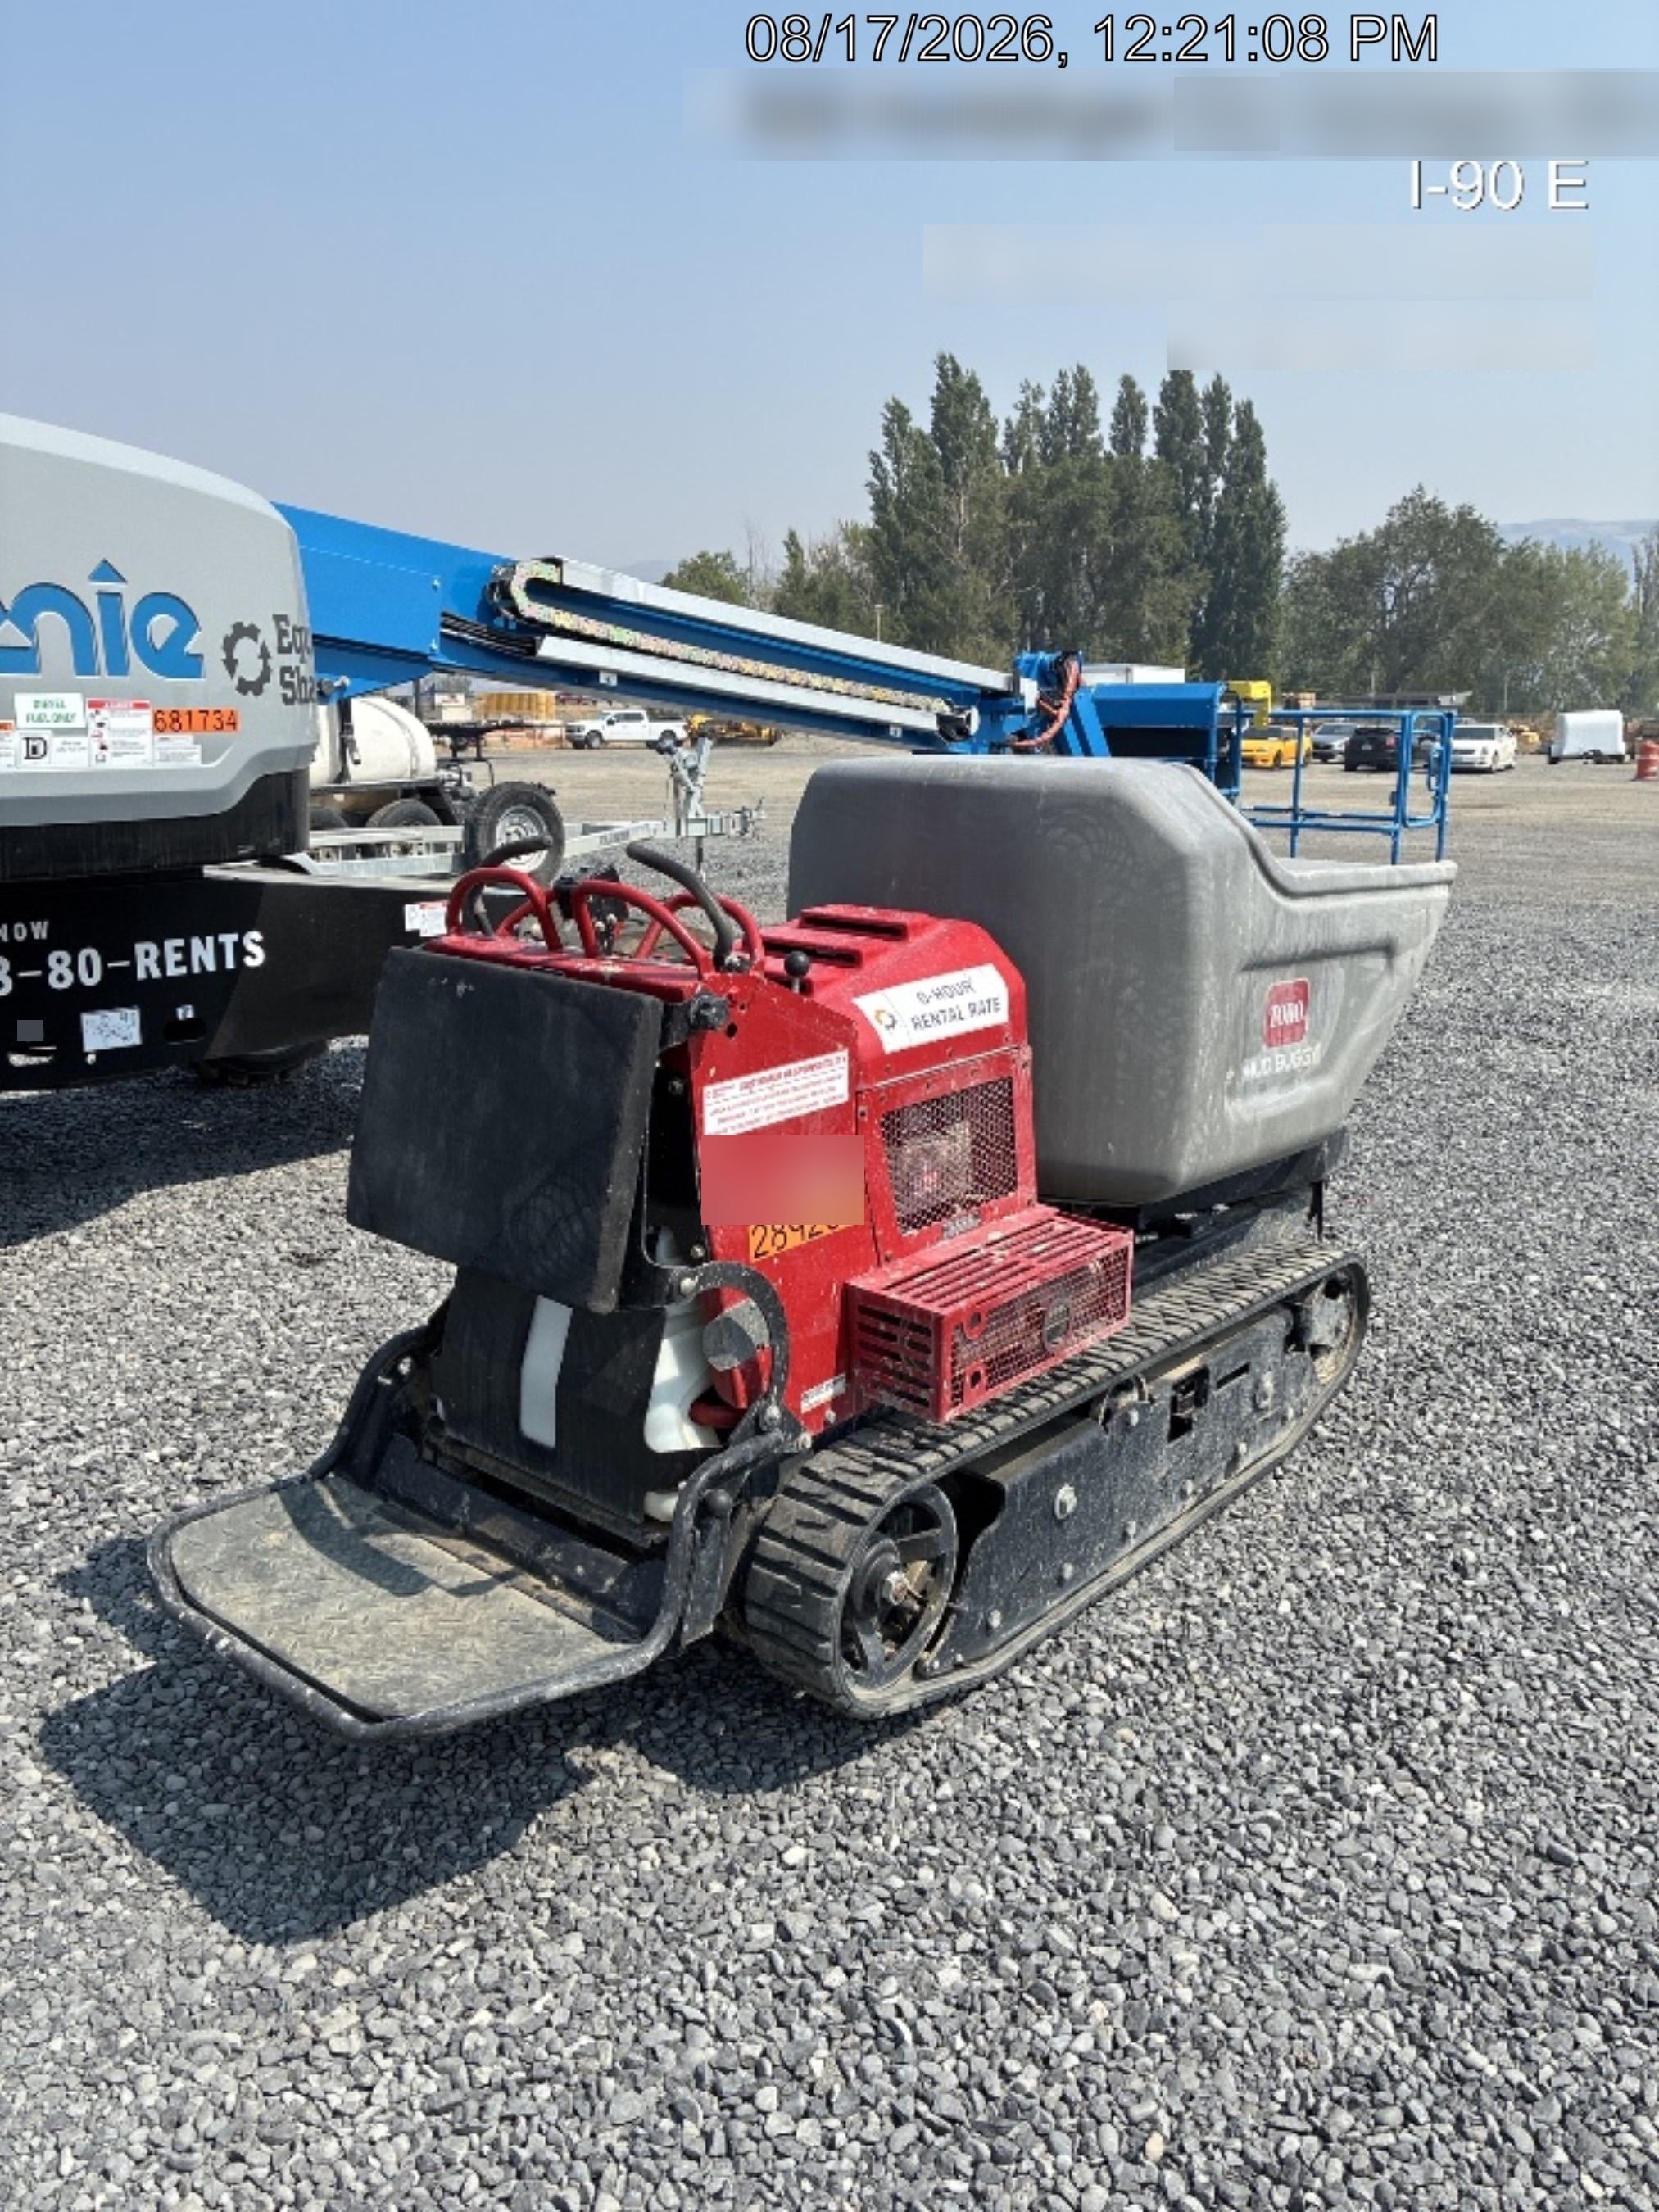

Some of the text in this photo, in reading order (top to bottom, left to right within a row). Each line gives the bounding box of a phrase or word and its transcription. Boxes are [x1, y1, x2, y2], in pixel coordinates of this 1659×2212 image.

[154, 709, 237, 732] 681734
[911, 997, 1001, 1030] RENTAL RATE
